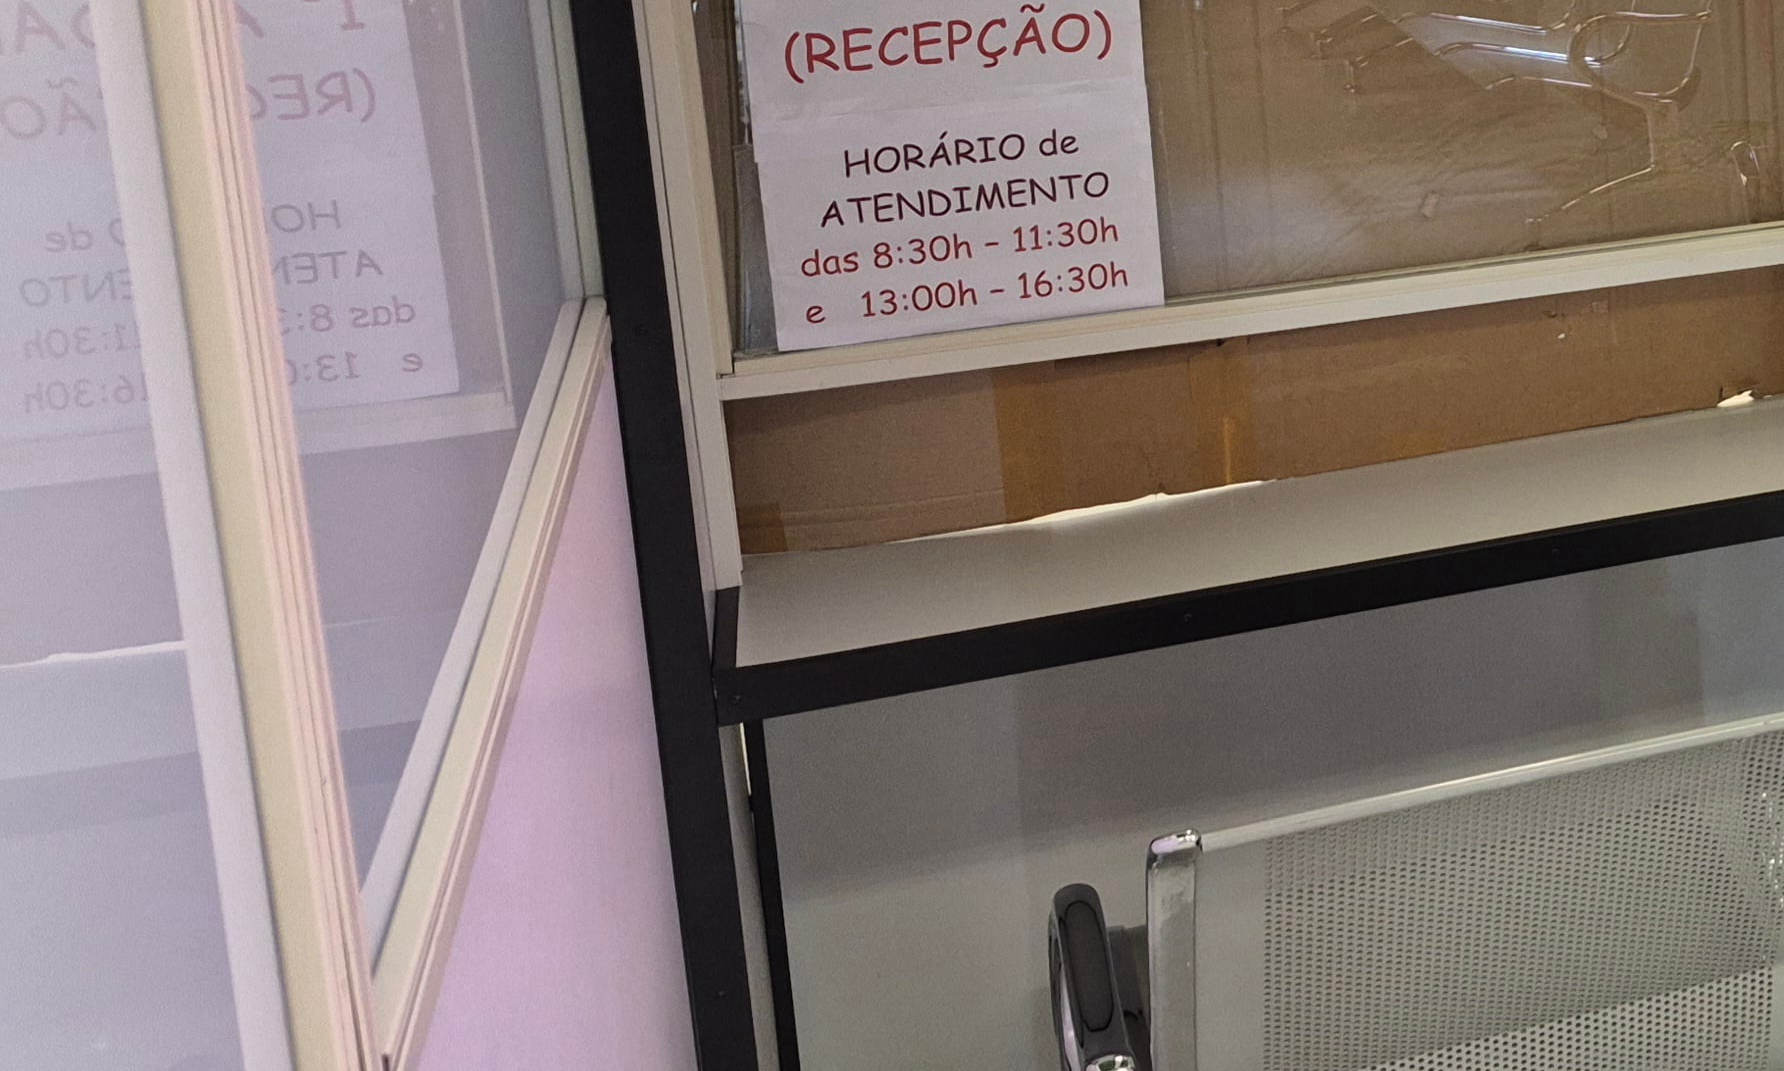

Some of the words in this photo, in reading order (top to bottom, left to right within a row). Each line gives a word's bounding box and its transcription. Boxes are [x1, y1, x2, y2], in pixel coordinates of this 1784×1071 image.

[784, 3, 1112, 85] (RECEPÇÃO)
[843, 131, 1026, 179] HORÁRIO
[1038, 128, 1079, 157] de
[820, 171, 1110, 228] ATENDIMENTO
[800, 248, 859, 278] das
[873, 232, 973, 269] 8:30h
[1012, 216, 1119, 253] 11:30h
[806, 305, 826, 324] e
[861, 279, 978, 318] 13:00h
[1018, 261, 1129, 299] 16:30h
